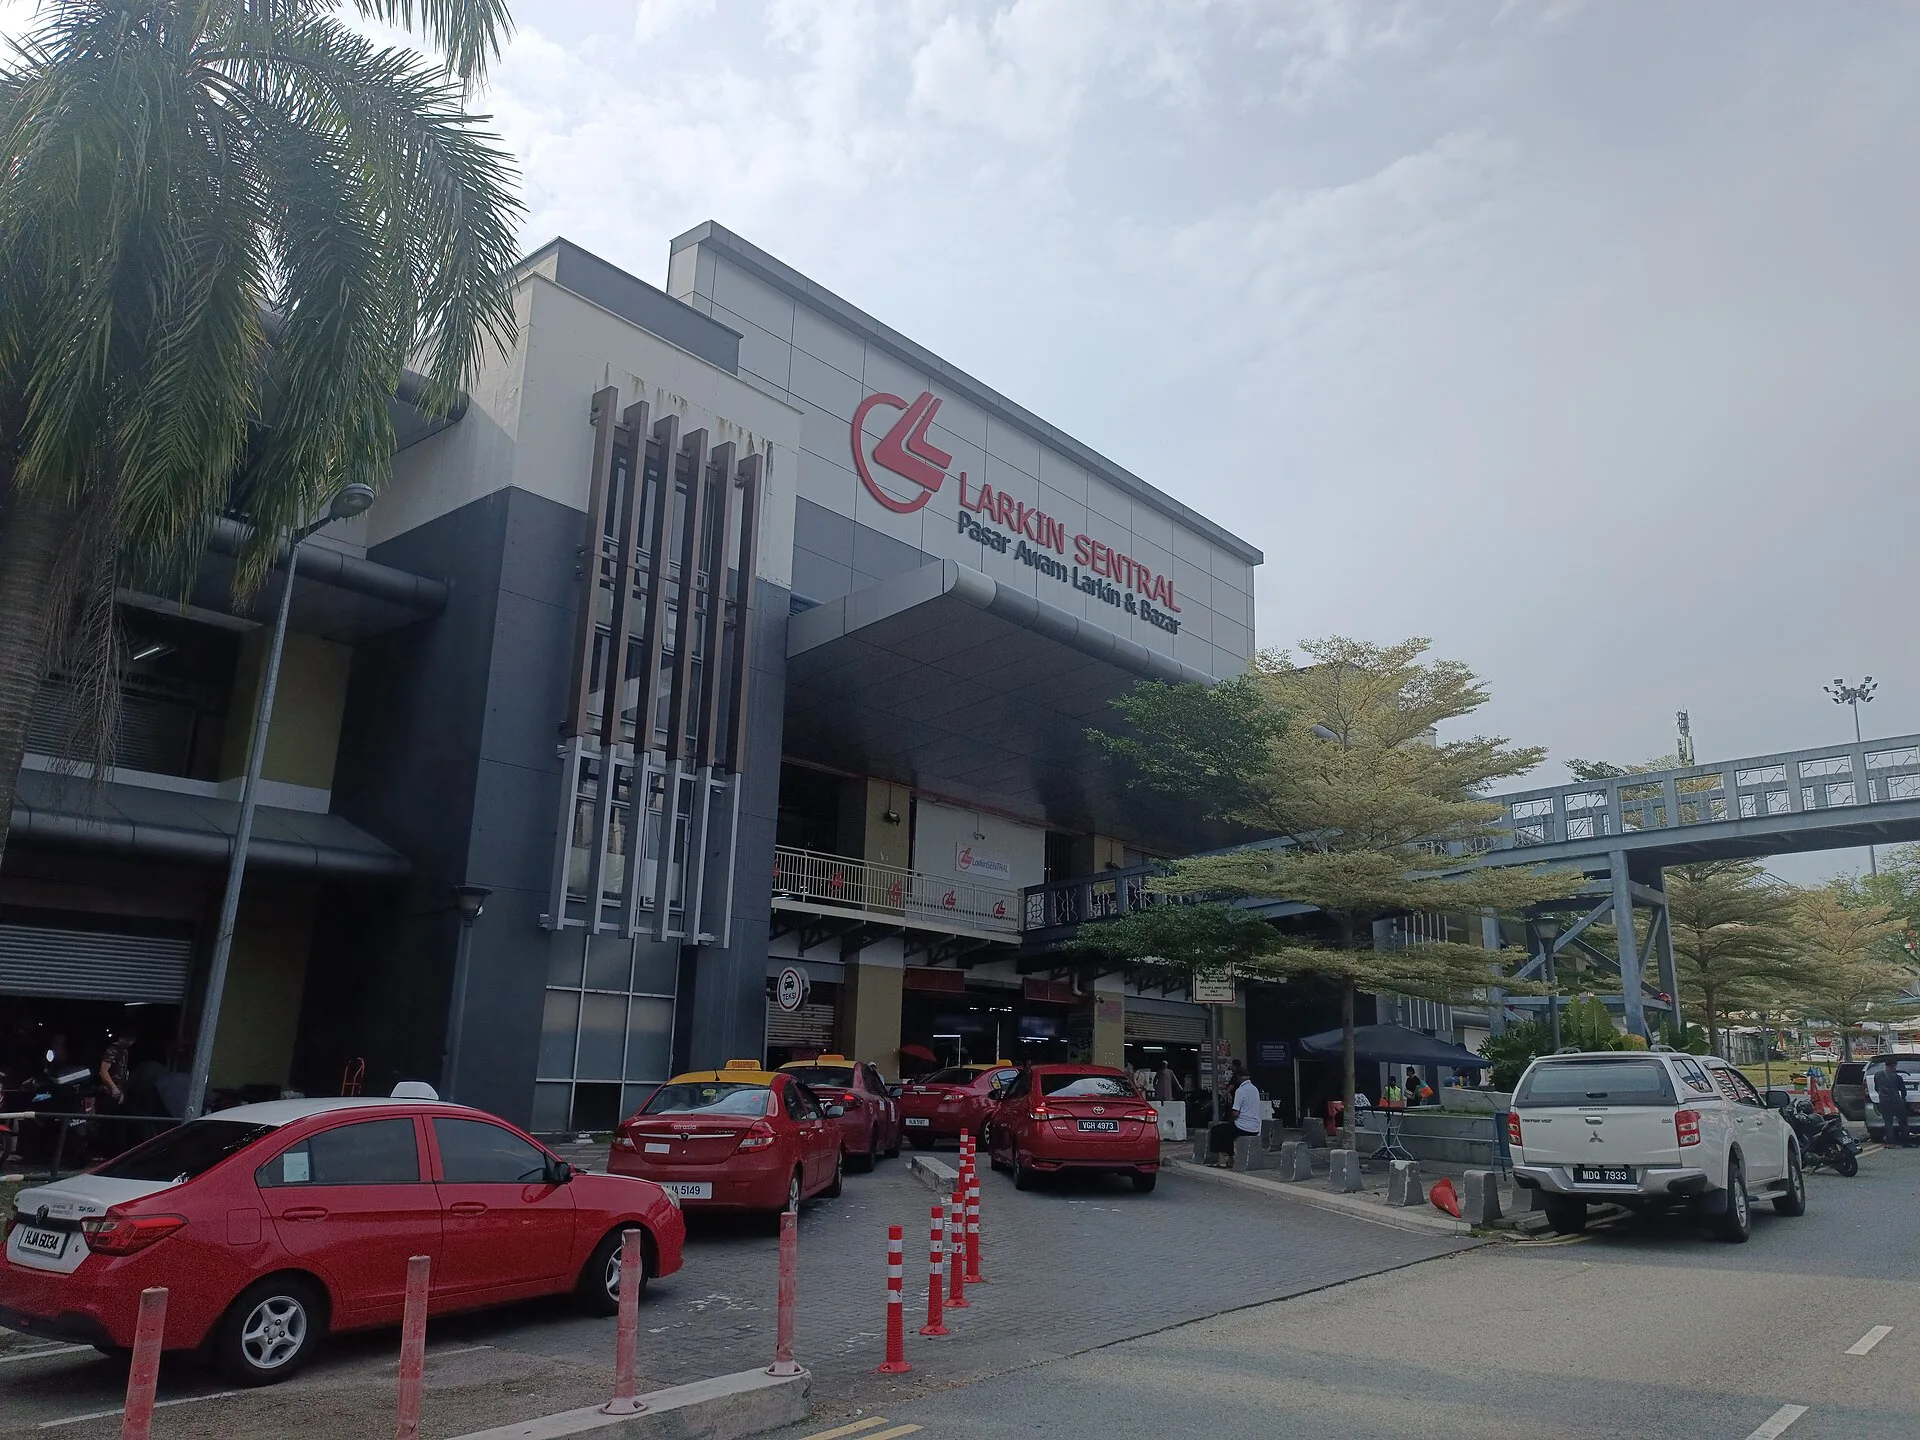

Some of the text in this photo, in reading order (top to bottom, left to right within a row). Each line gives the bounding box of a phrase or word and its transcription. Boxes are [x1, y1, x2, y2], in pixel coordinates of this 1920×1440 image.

[960, 472, 1181, 612] LARKIN SENTRAL
[958, 510, 1181, 634] Pasar Awam Larkin & Bazar
[972, 858, 1008, 873] LarkinSENTRAL
[783, 992, 796, 1002] TEKSI
[1082, 1121, 1114, 1130] VGH 4973
[1582, 1170, 1627, 1180] MDQ 7933
[681, 1185, 700, 1195] 5149
[24, 1230, 60, 1250] HJA 6034
